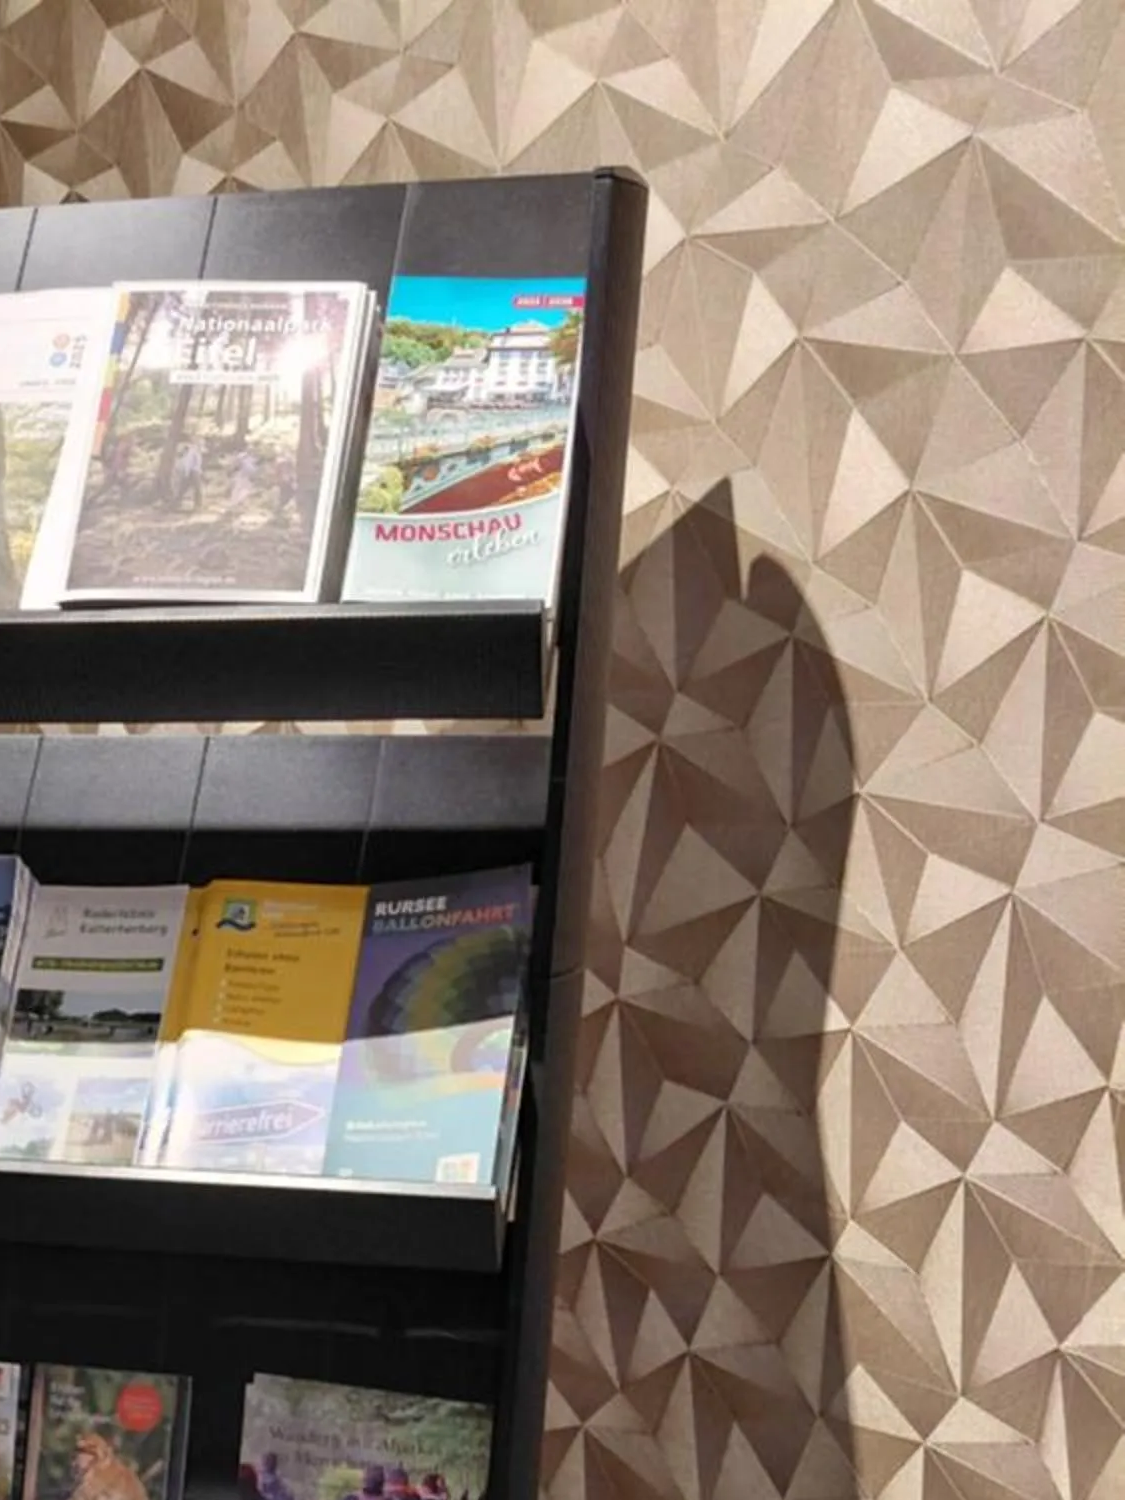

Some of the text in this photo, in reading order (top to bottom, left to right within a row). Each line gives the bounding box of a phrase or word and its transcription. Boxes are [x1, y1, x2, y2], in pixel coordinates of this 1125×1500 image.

[181, 334, 257, 372] Eifel
[375, 513, 522, 541] MONSCHAU
[372, 903, 516, 933] BALLONFAHRT
[375, 896, 448, 917] RURSEE
